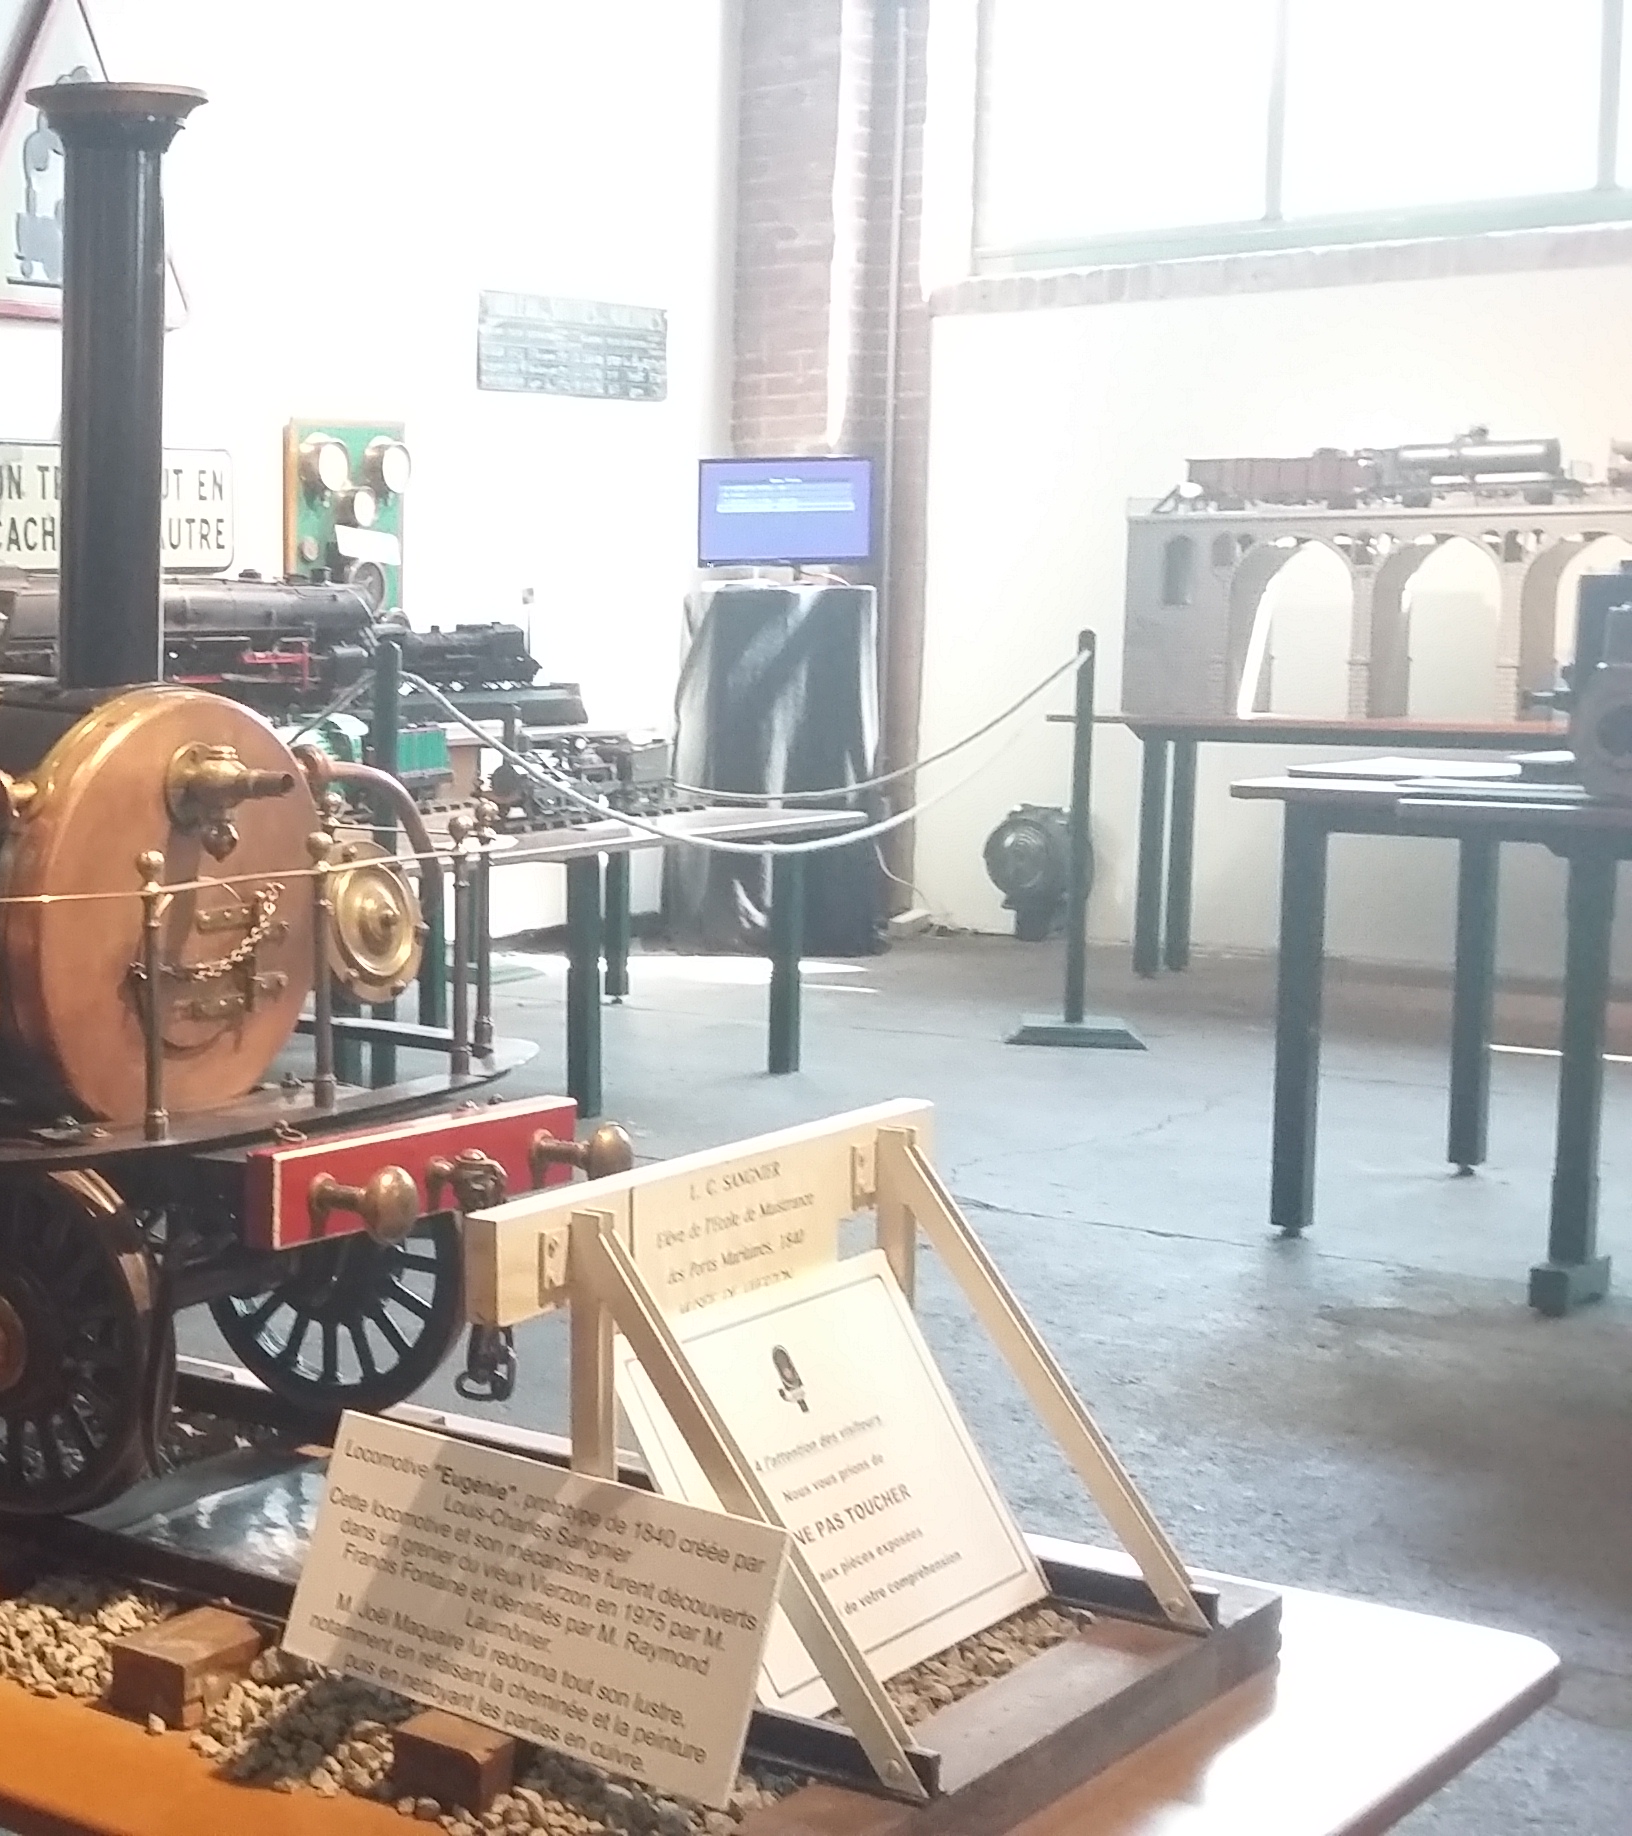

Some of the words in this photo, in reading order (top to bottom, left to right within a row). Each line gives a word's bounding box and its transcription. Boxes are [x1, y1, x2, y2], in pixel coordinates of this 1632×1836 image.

[162, 469, 183, 500] UT
[198, 469, 223, 501] EN
[820, 1432, 838, 1448] des
[783, 1485, 810, 1502] Nous
[812, 1475, 837, 1491] vous
[838, 1461, 870, 1483] prions
[871, 1453, 884, 1466] de
[329, 1486, 369, 1513] Cette
[371, 1499, 452, 1538] locomotive
[454, 1528, 472, 1544] et
[473, 1533, 504, 1554] son
[816, 1512, 845, 1538] PAS
[845, 1483, 911, 1524] TOUCHER
[606, 1516, 628, 1535] de
[634, 1520, 677, 1549] 1840
[732, 1553, 767, 1574] par
[339, 1517, 377, 1541] dans
[380, 1534, 400, 1549] un
[458, 1555, 480, 1574] du
[530, 1572, 592, 1609] Vierzon
[595, 1598, 618, 1617] en
[625, 1604, 666, 1632] 1975
[668, 1621, 701, 1642] par
[703, 1627, 725, 1652] M.
[820, 1568, 839, 1583] aux
[844, 1600, 858, 1615] de
[859, 1586, 885, 1607] votre
[342, 1541, 398, 1576] Francis
[470, 1587, 488, 1605] et
[564, 1617, 596, 1638] par
[623, 1631, 711, 1677] Raymond
[394, 1644, 415, 1661] en
[488, 1672, 504, 1694] la
[592, 1712, 611, 1731] et
[613, 1715, 630, 1737] la
[468, 1638, 487, 1658] lui
[561, 1669, 595, 1696] tout
[596, 1685, 630, 1708] son
[379, 1666, 399, 1682] en
[478, 1697, 501, 1720] les
[564, 1732, 587, 1749] en
